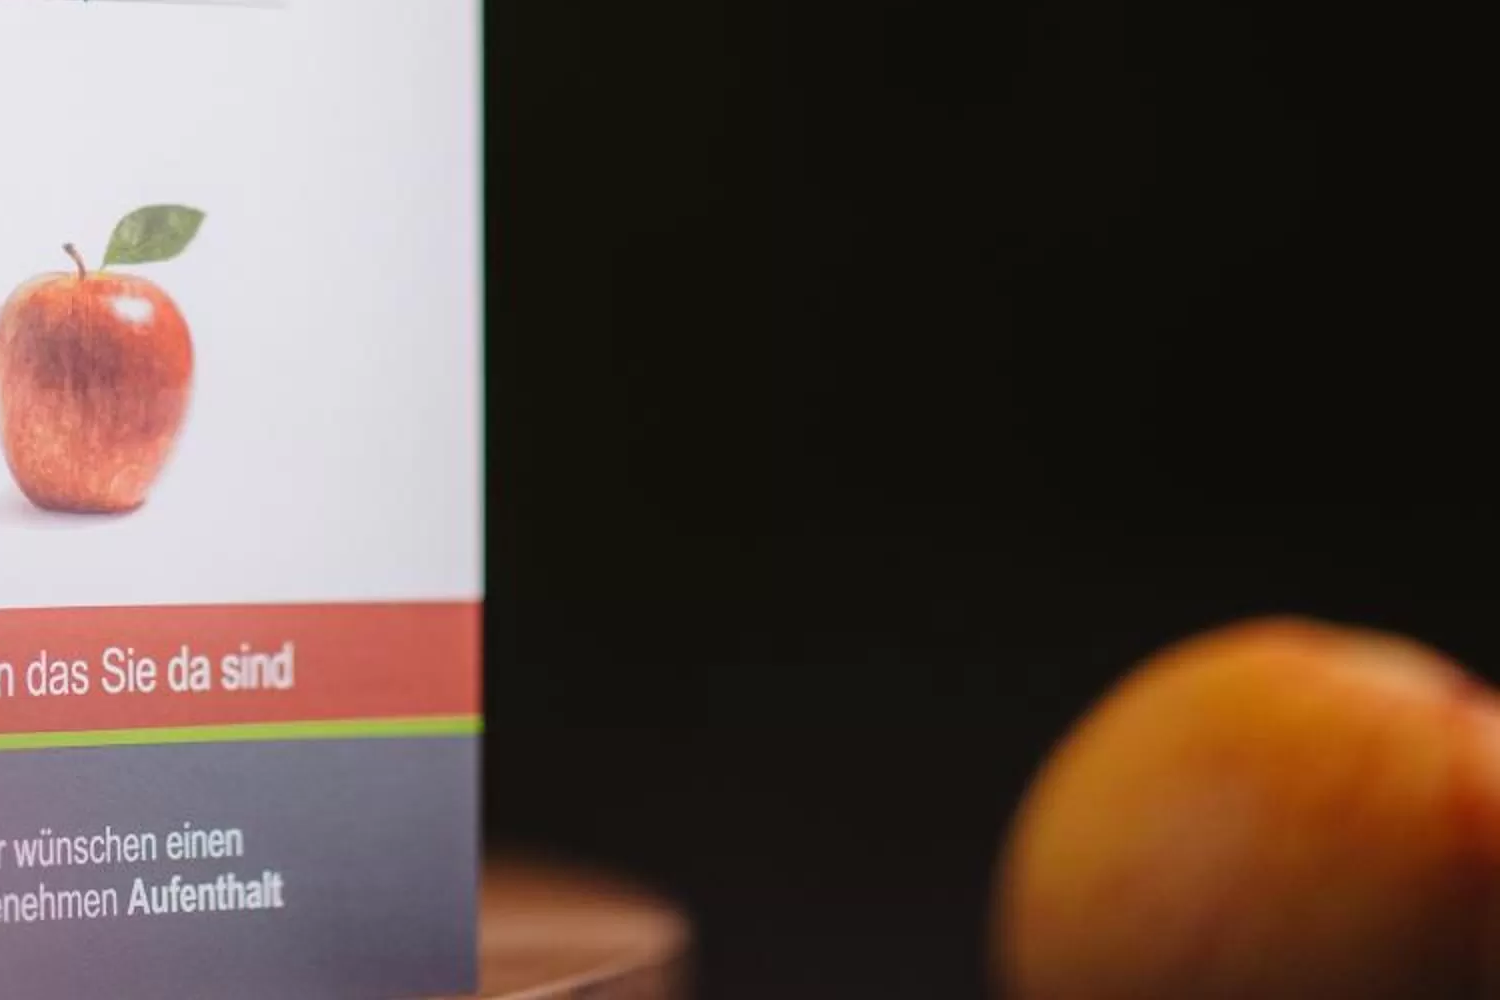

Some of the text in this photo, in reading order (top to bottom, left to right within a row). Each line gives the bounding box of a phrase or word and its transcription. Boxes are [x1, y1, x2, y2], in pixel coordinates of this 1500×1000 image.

[26, 649, 90, 697] das
[101, 646, 156, 694] Sie
[167, 644, 211, 692] da
[220, 640, 295, 690] sind
[13, 825, 157, 867] wünschen
[166, 822, 243, 859] einen
[127, 870, 284, 915] Aufenthalt
